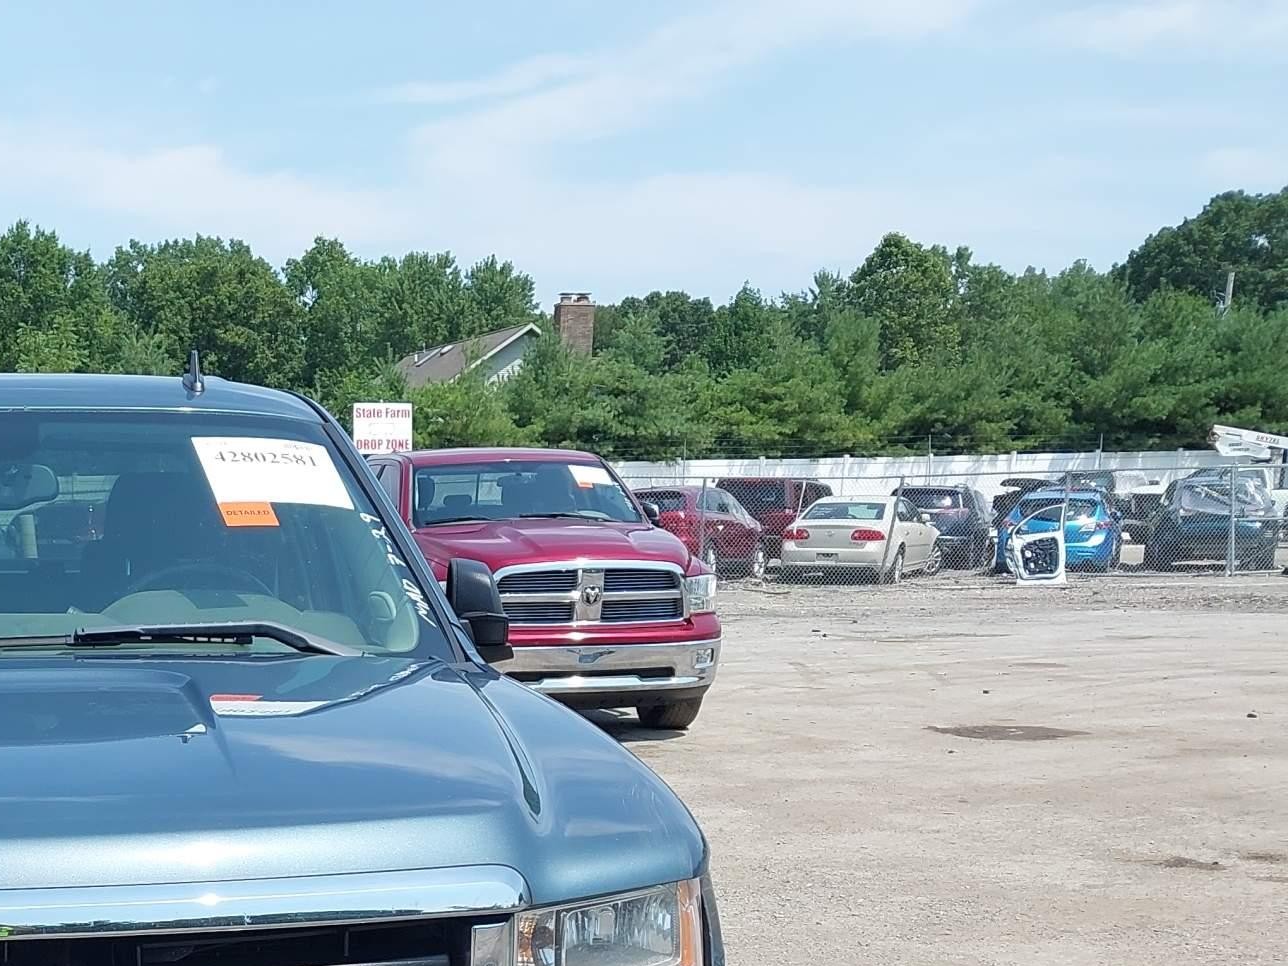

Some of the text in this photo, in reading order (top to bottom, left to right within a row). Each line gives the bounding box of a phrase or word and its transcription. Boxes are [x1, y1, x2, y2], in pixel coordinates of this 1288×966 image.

[355, 407, 410, 419] State Farm
[356, 438, 410, 450] DROP ZONE
[214, 450, 318, 467] 42802581
[225, 509, 271, 517] DETAILED
